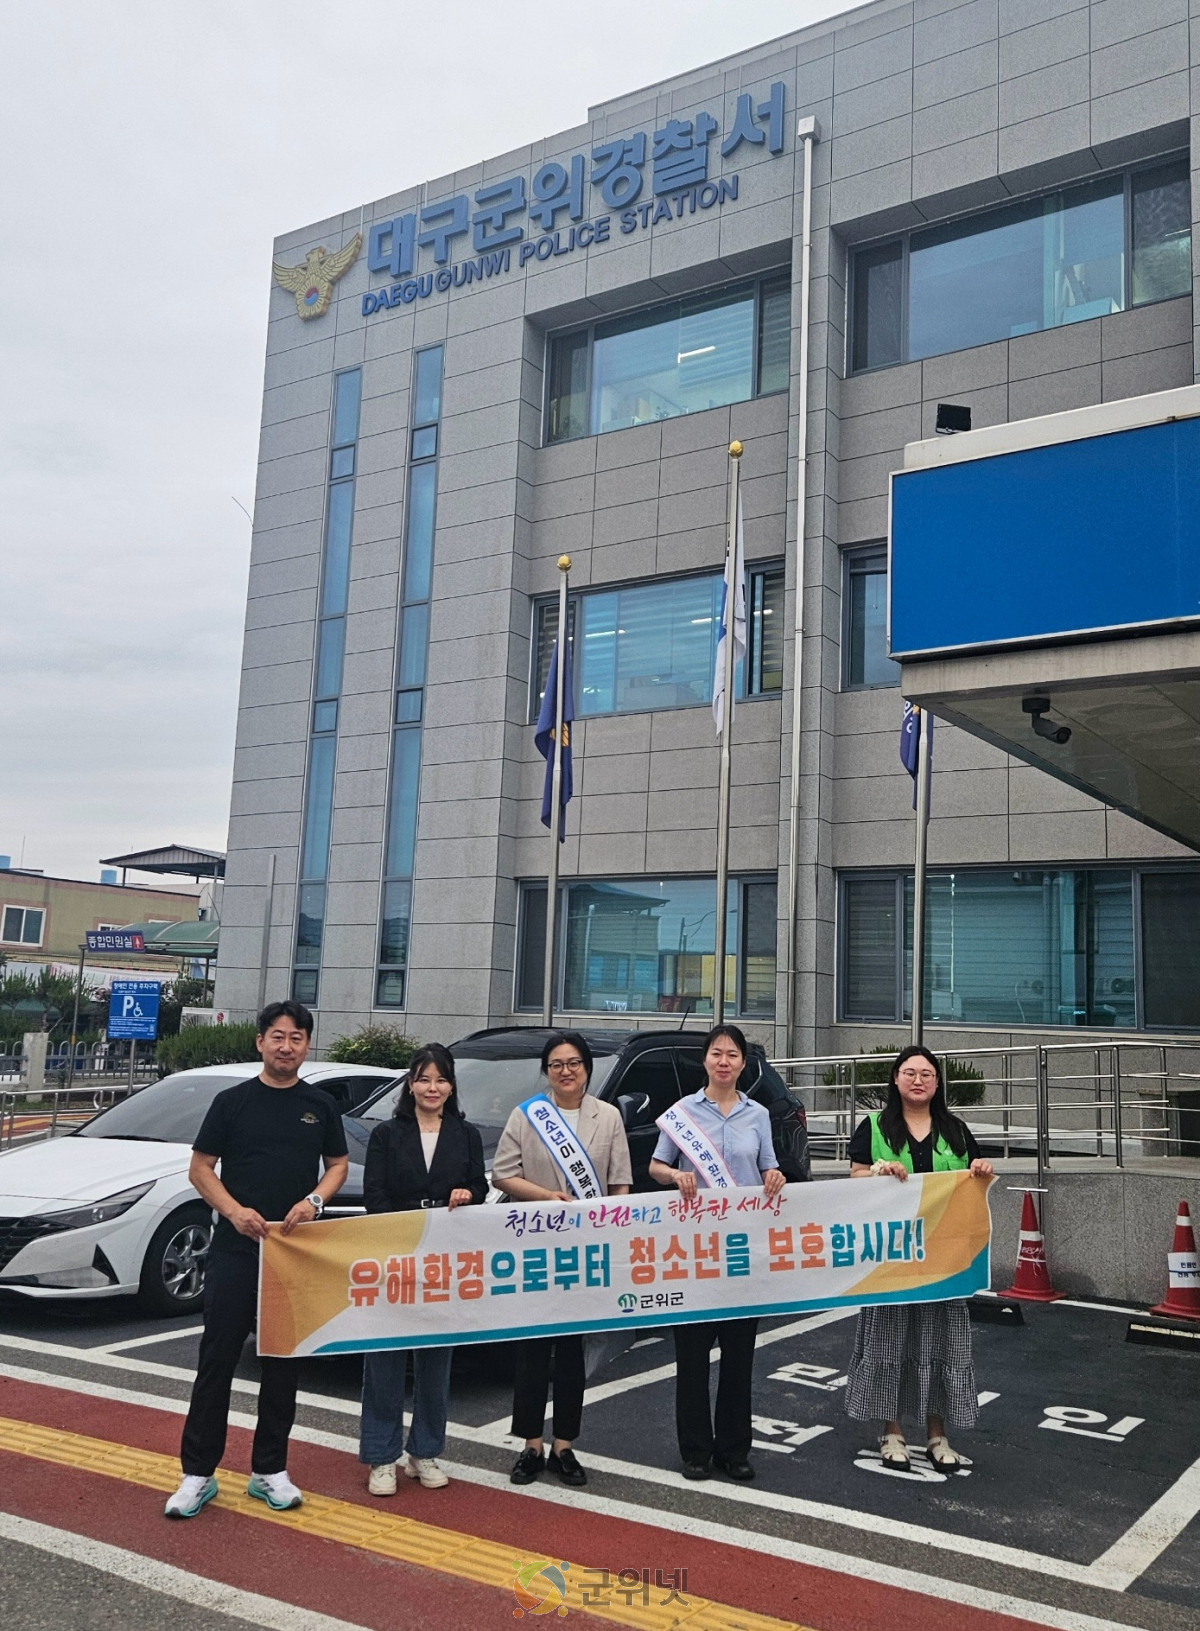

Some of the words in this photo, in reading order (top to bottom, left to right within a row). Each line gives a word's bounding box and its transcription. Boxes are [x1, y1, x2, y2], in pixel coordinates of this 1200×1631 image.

[367, 80, 785, 278] 대구군위경찰서
[362, 273, 432, 316] DAEGU
[434, 248, 511, 292] GUNWI
[519, 216, 610, 268] POLICE
[619, 174, 739, 233] STATION
[87, 935, 133, 949] 종합민원실
[122, 995, 134, 1017] P
[534, 1106, 575, 1159] 청소년이
[665, 1110, 728, 1188] 청소년유해환경
[505, 1209, 581, 1238] 청소년이
[588, 1204, 662, 1229] 안전하고
[667, 1197, 732, 1224] 행복한
[737, 1195, 787, 1217] 세상
[350, 1243, 611, 1307] 유해환경으로부터
[629, 1231, 750, 1286] 청소년을
[768, 1218, 926, 1272] 보호합시다!
[640, 1292, 685, 1309] 군위군
